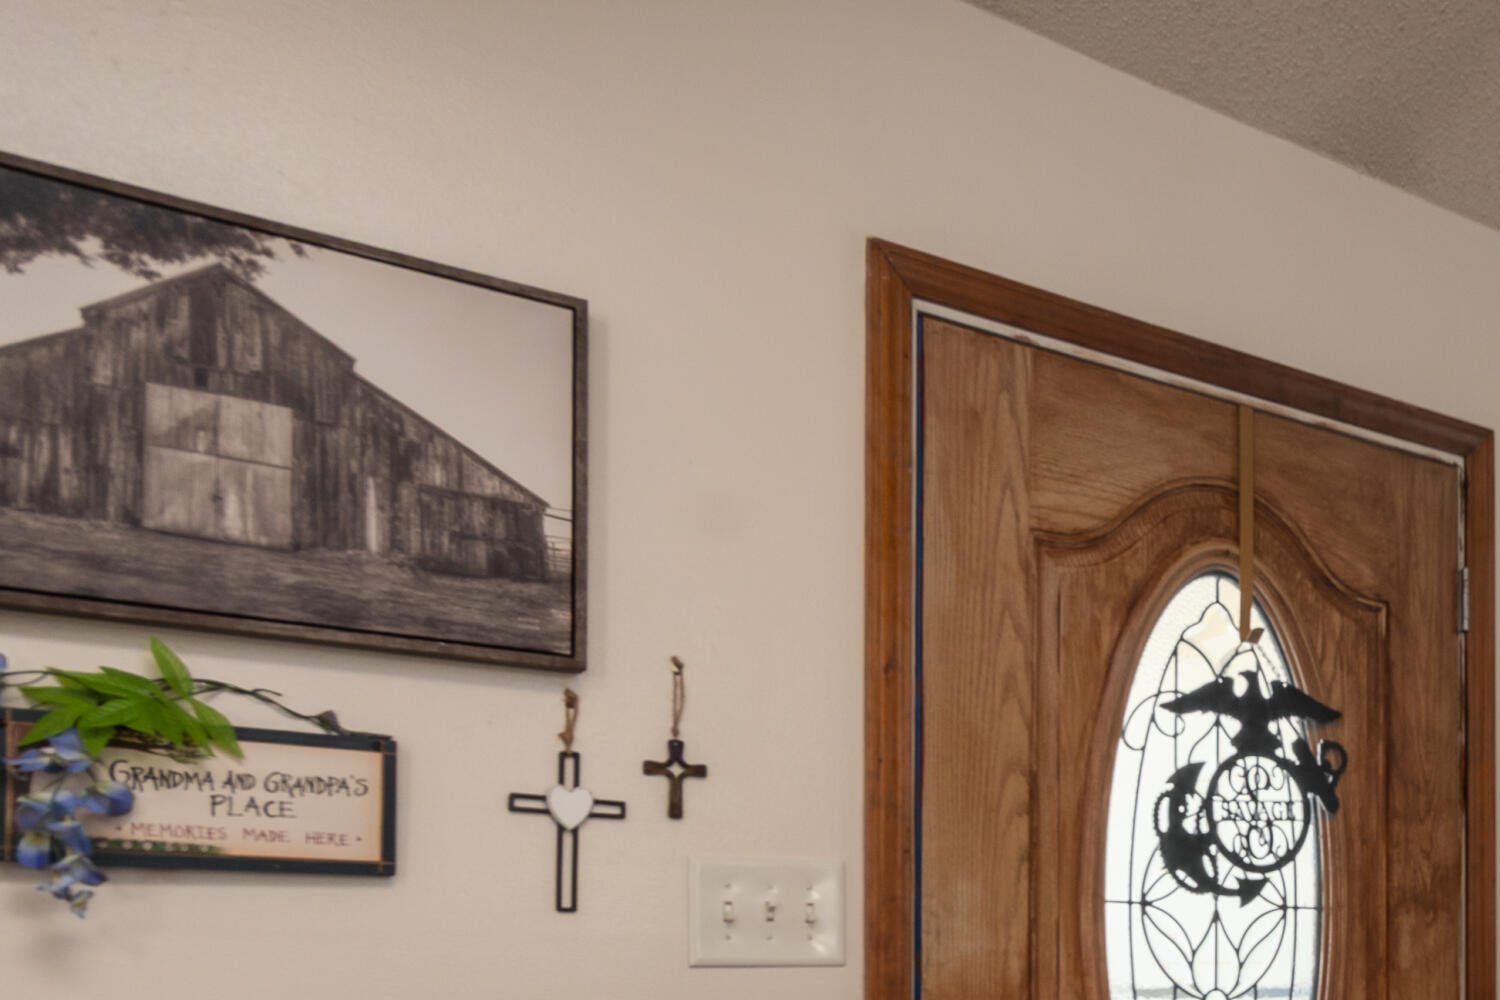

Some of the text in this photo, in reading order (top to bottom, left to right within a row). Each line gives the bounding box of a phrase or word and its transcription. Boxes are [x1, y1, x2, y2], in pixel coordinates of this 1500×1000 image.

[109, 759, 369, 798] GRANDMA AND GRANDPA'S
[210, 794, 297, 818] PLACE
[130, 822, 351, 847] MEMORIES MADE HERE
